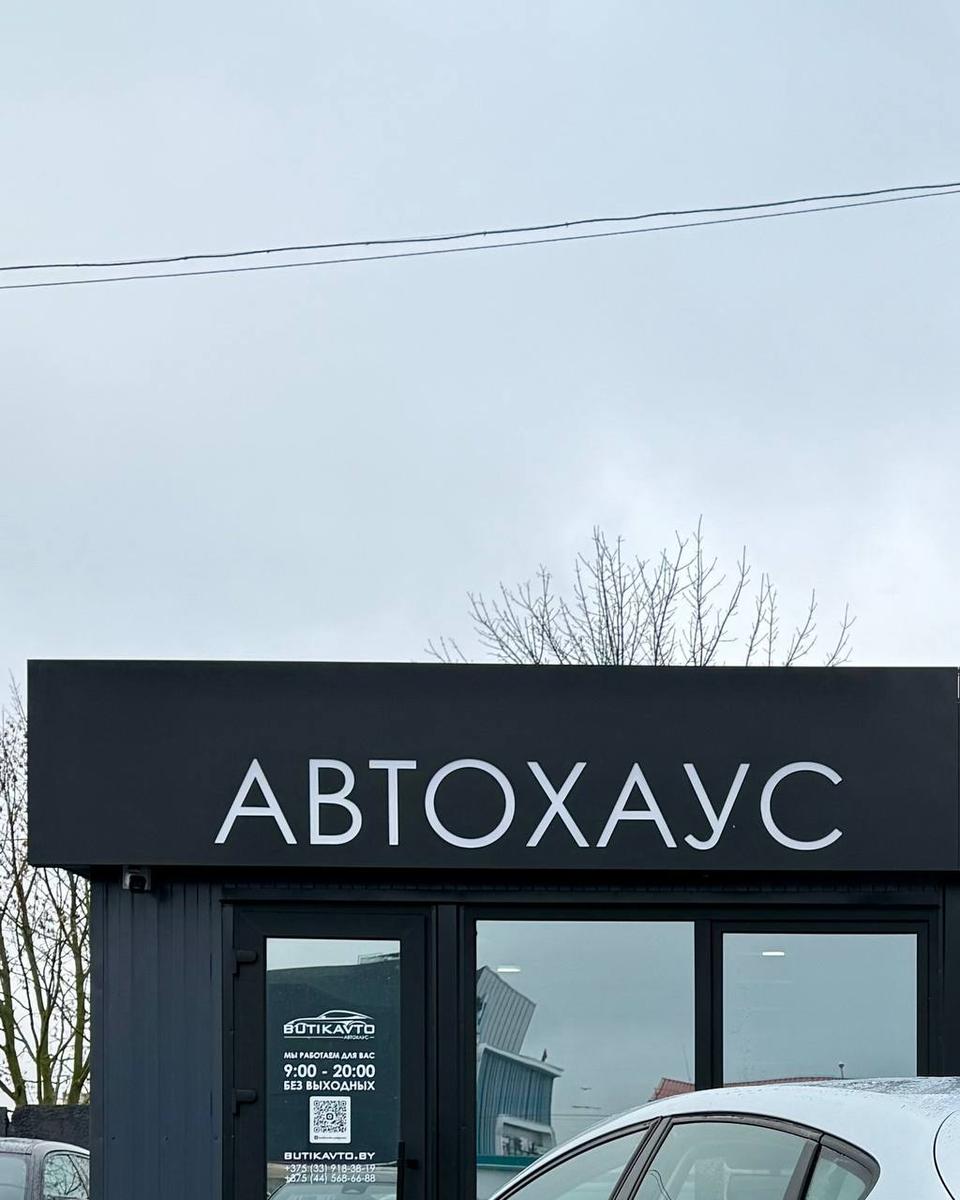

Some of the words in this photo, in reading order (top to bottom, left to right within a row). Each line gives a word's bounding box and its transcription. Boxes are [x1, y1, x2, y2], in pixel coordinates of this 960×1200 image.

[214, 758, 843, 851] АВТОХАУС
[283, 1024, 375, 1034] BUTIKAVTO
[341, 1052, 358, 1060] ДЛЯ
[284, 1064, 317, 1078] 9:00
[333, 1064, 376, 1078] 20:00
[283, 1081, 303, 1091] БЕЗ
[306, 1081, 376, 1091] ВЫХОДНЫХ
[284, 1152, 376, 1160] BUTIKAVTO.BY
[310, 1164, 328, 1174] (33)
[310, 1173, 328, 1184] (44)
[331, 1174, 376, 1183] 568-66-88
